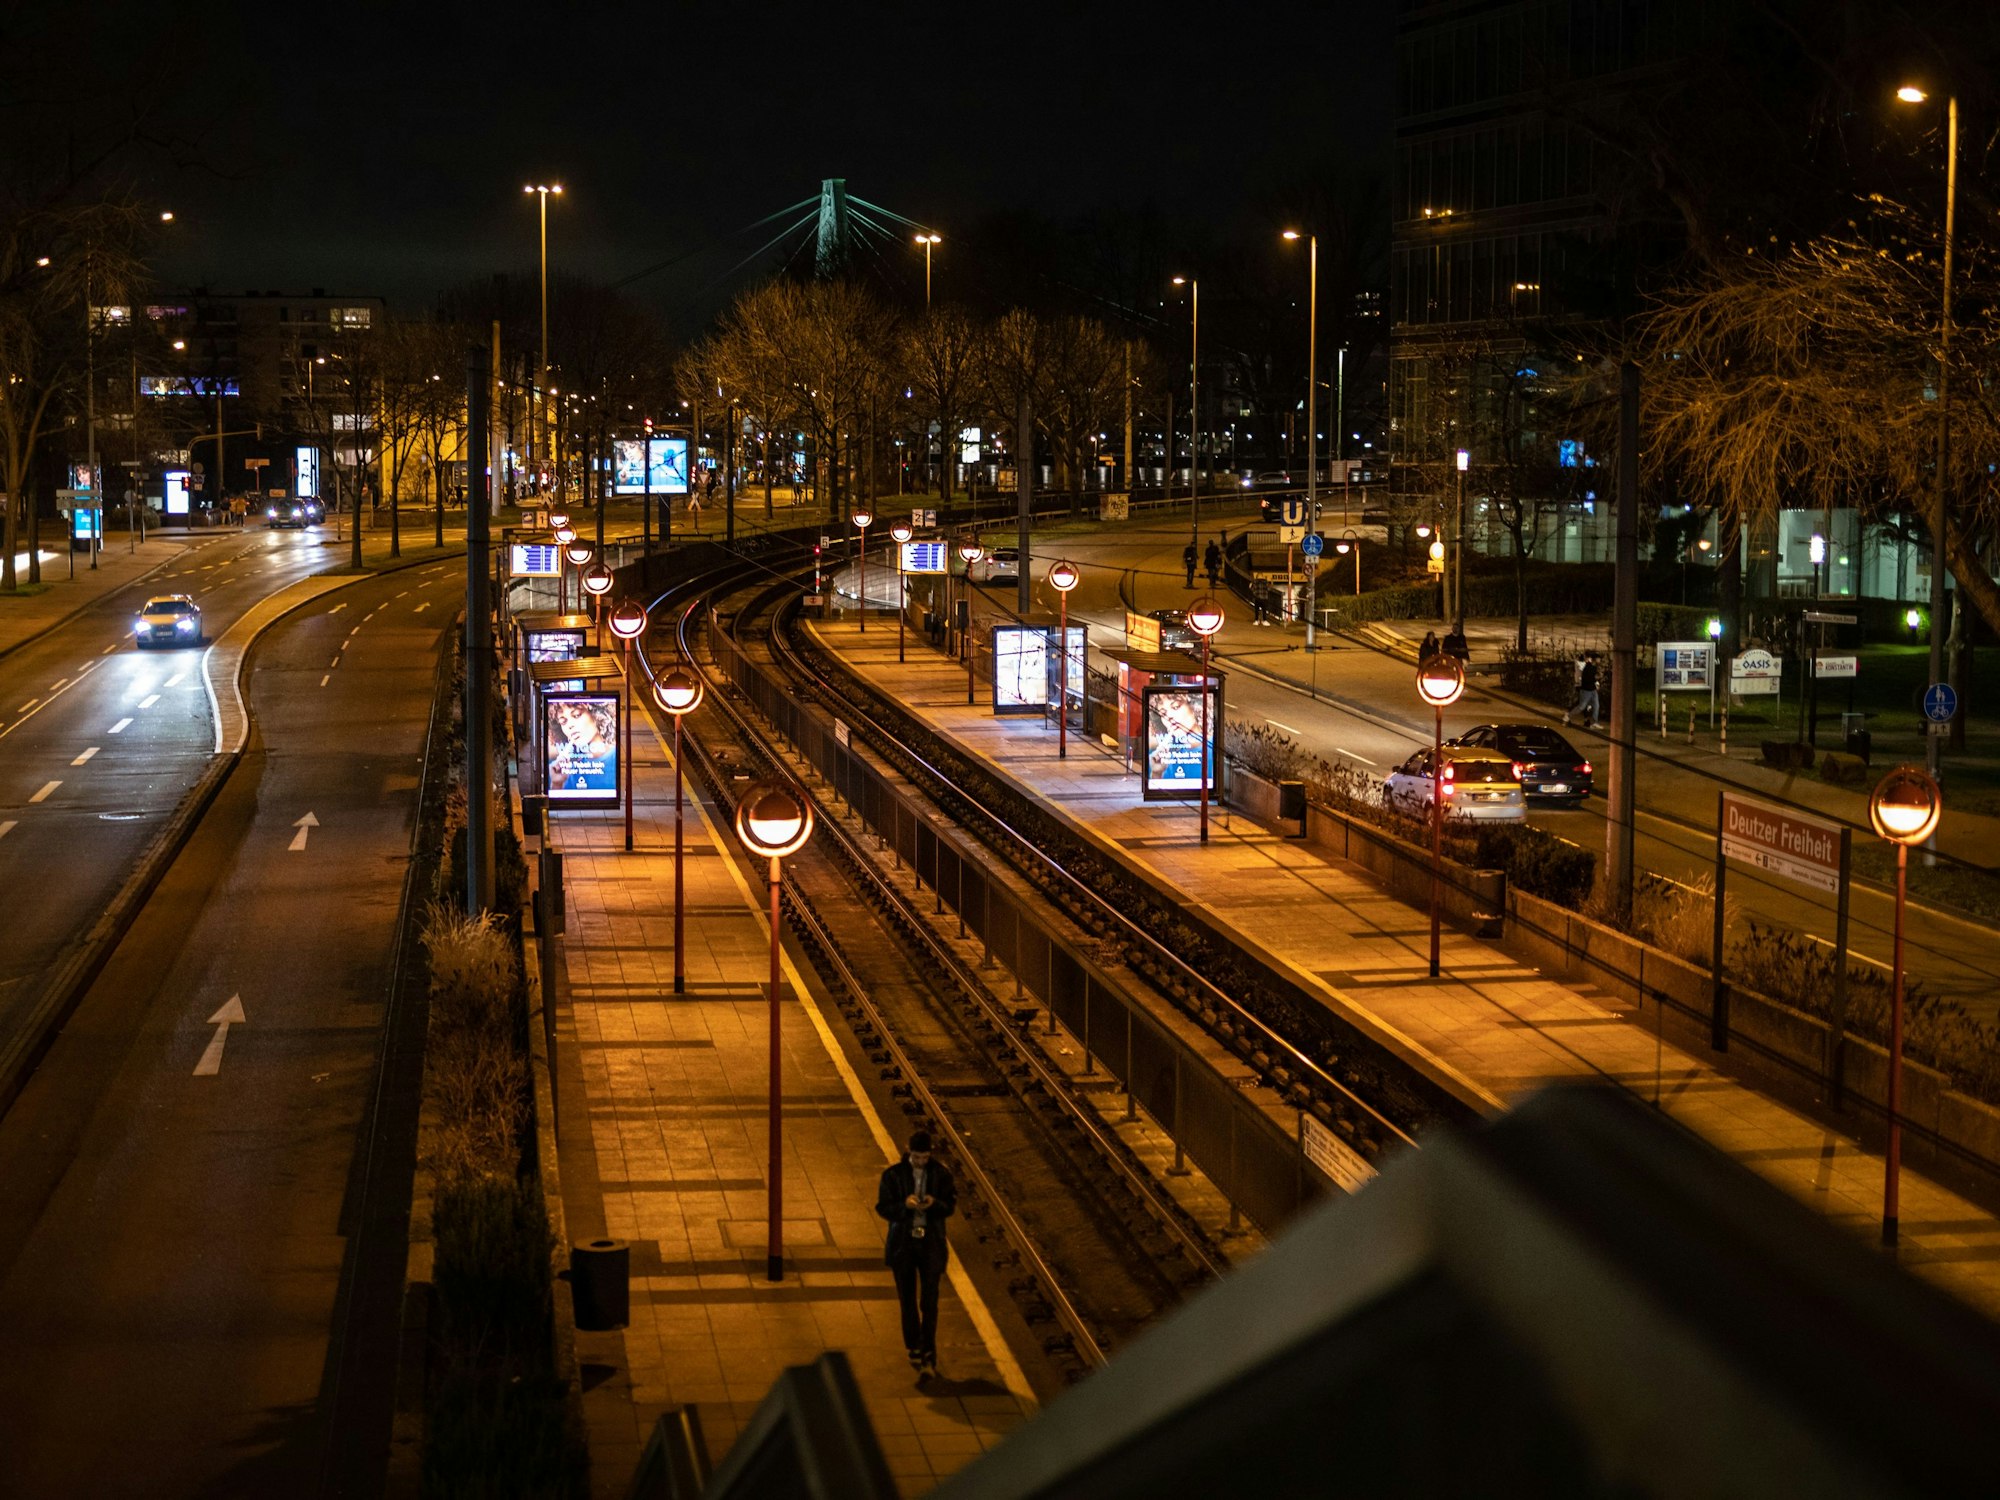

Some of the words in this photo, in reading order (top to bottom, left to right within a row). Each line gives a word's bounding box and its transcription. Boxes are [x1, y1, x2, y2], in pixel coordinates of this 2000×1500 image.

[1283, 501, 1304, 525] U
[1742, 659, 1771, 669] OASIS
[1729, 805, 1778, 845] Deutzer
[1781, 822, 1833, 863] Freiheit
